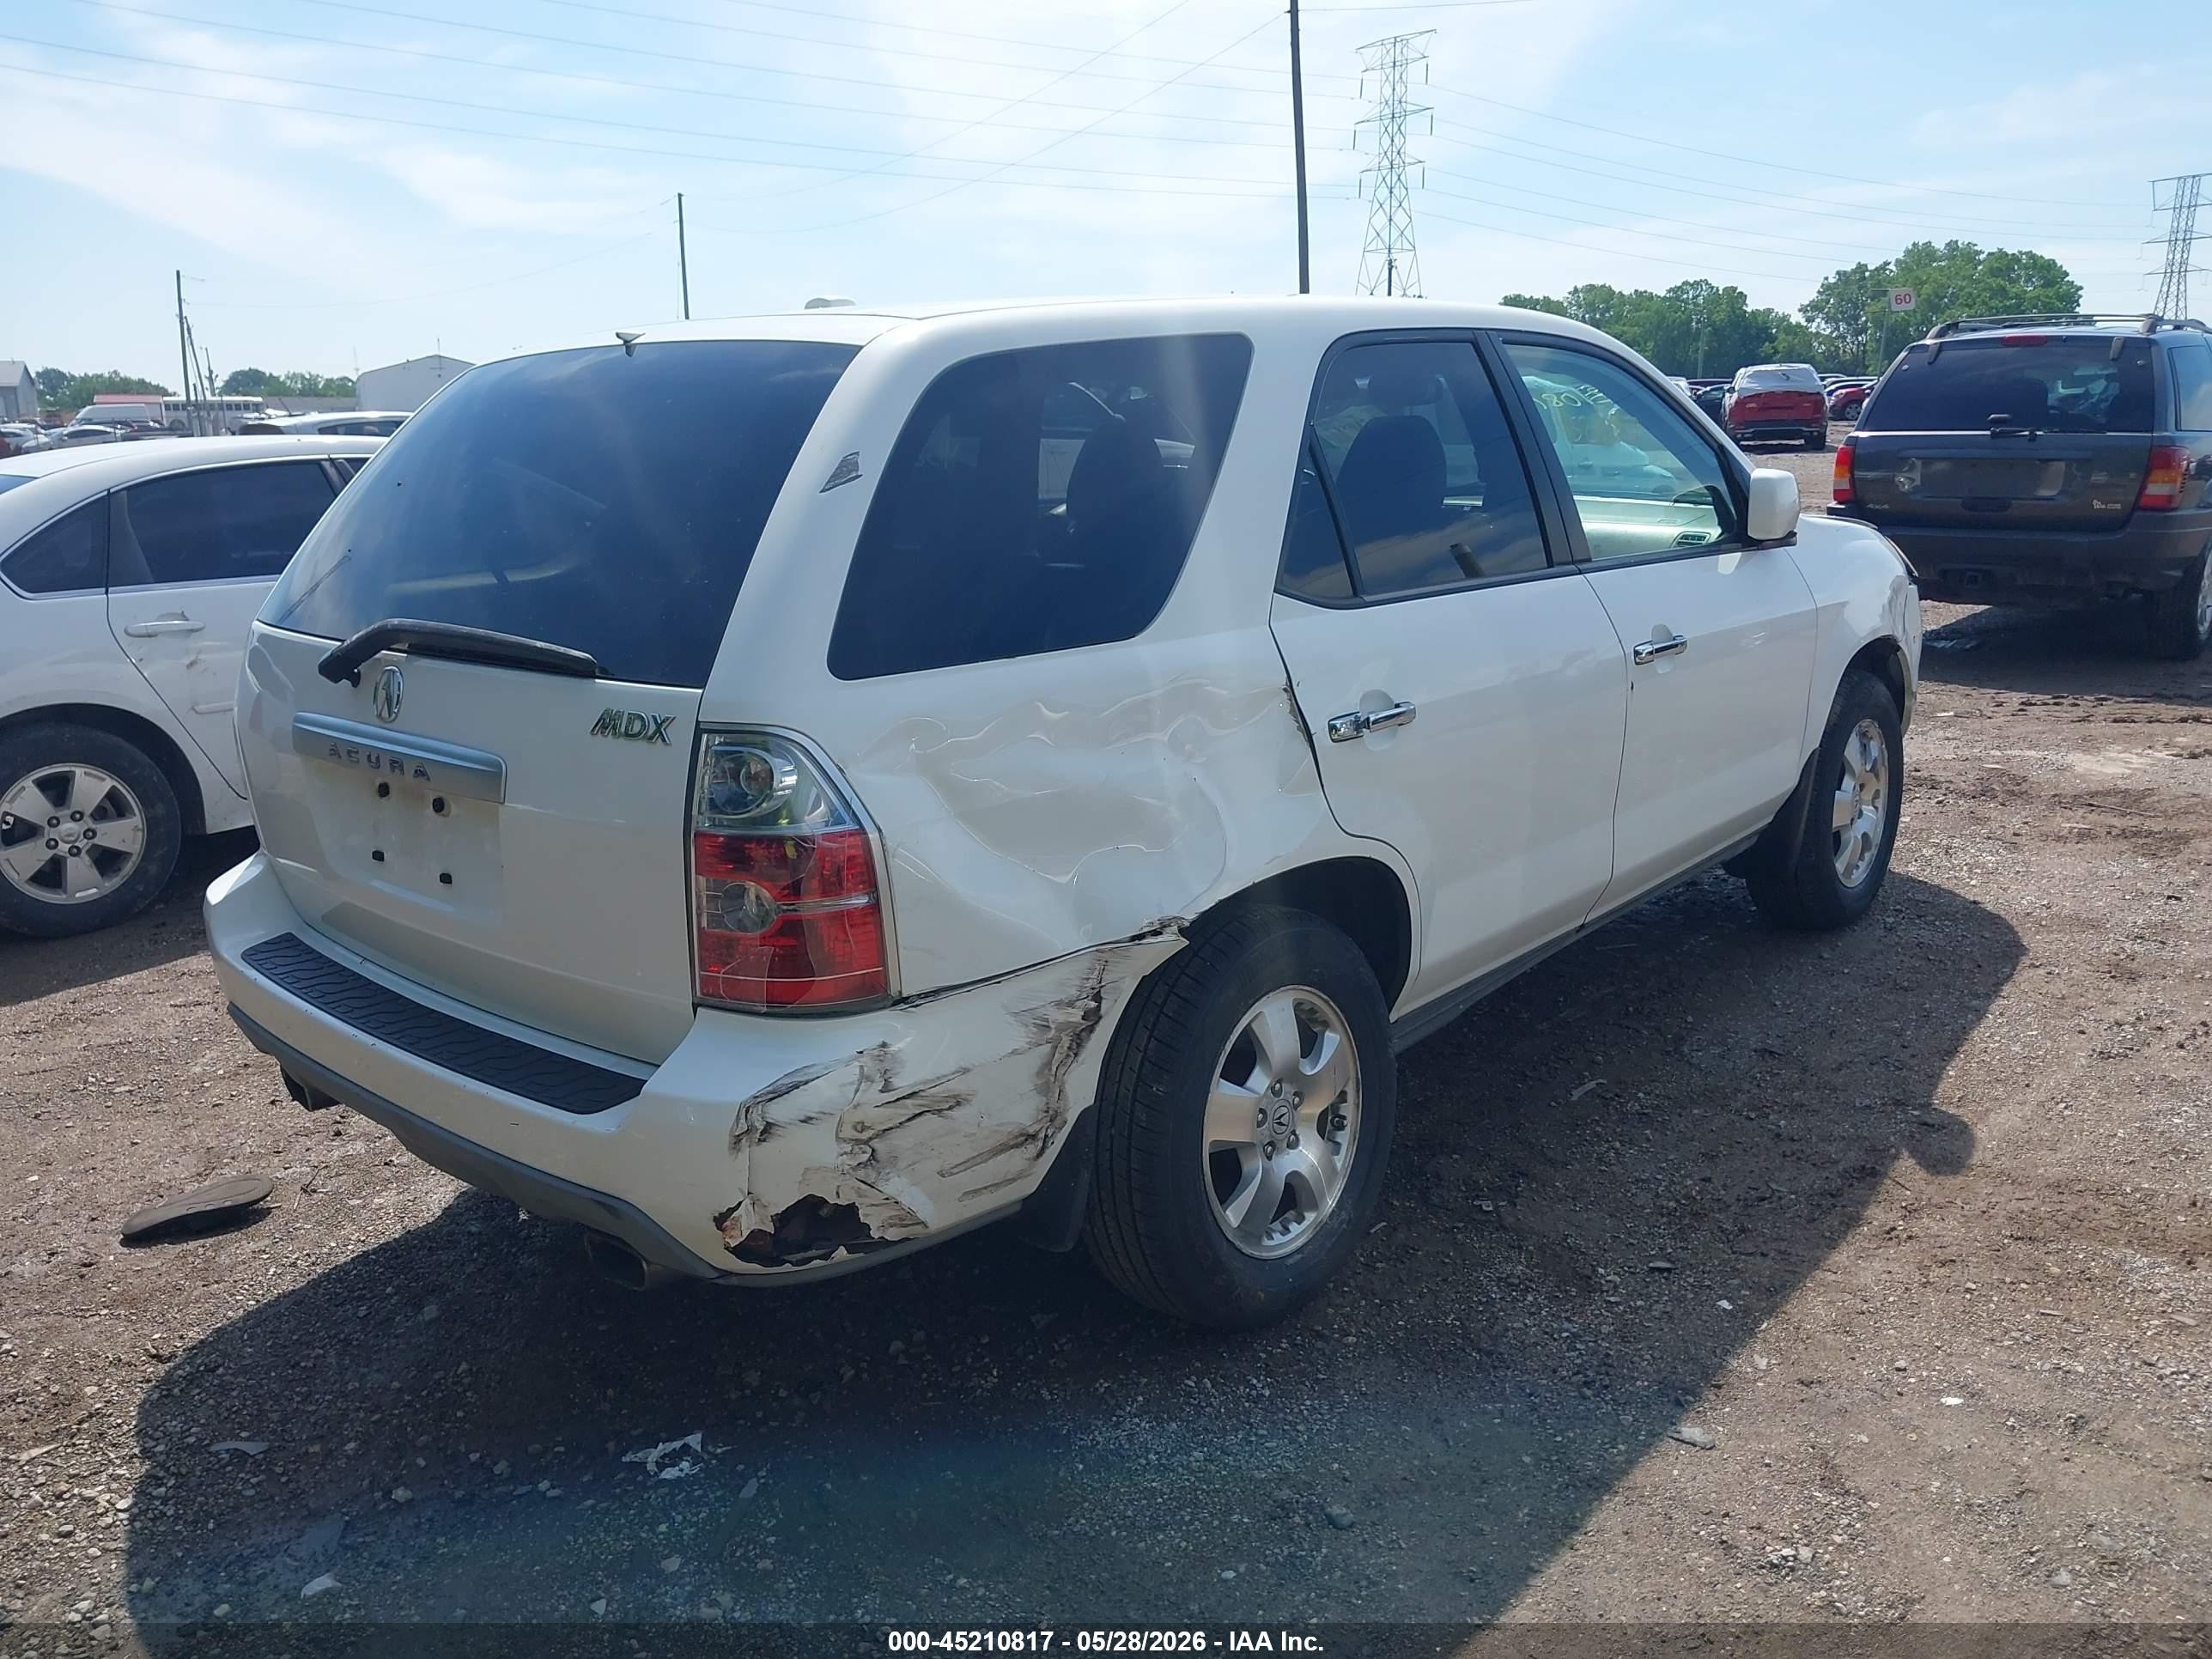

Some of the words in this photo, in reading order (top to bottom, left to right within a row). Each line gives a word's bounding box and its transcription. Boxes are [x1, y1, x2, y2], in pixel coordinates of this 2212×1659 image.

[1894, 293, 1911, 306] 60
[590, 707, 677, 746] MDX
[329, 741, 431, 781] ACURA
